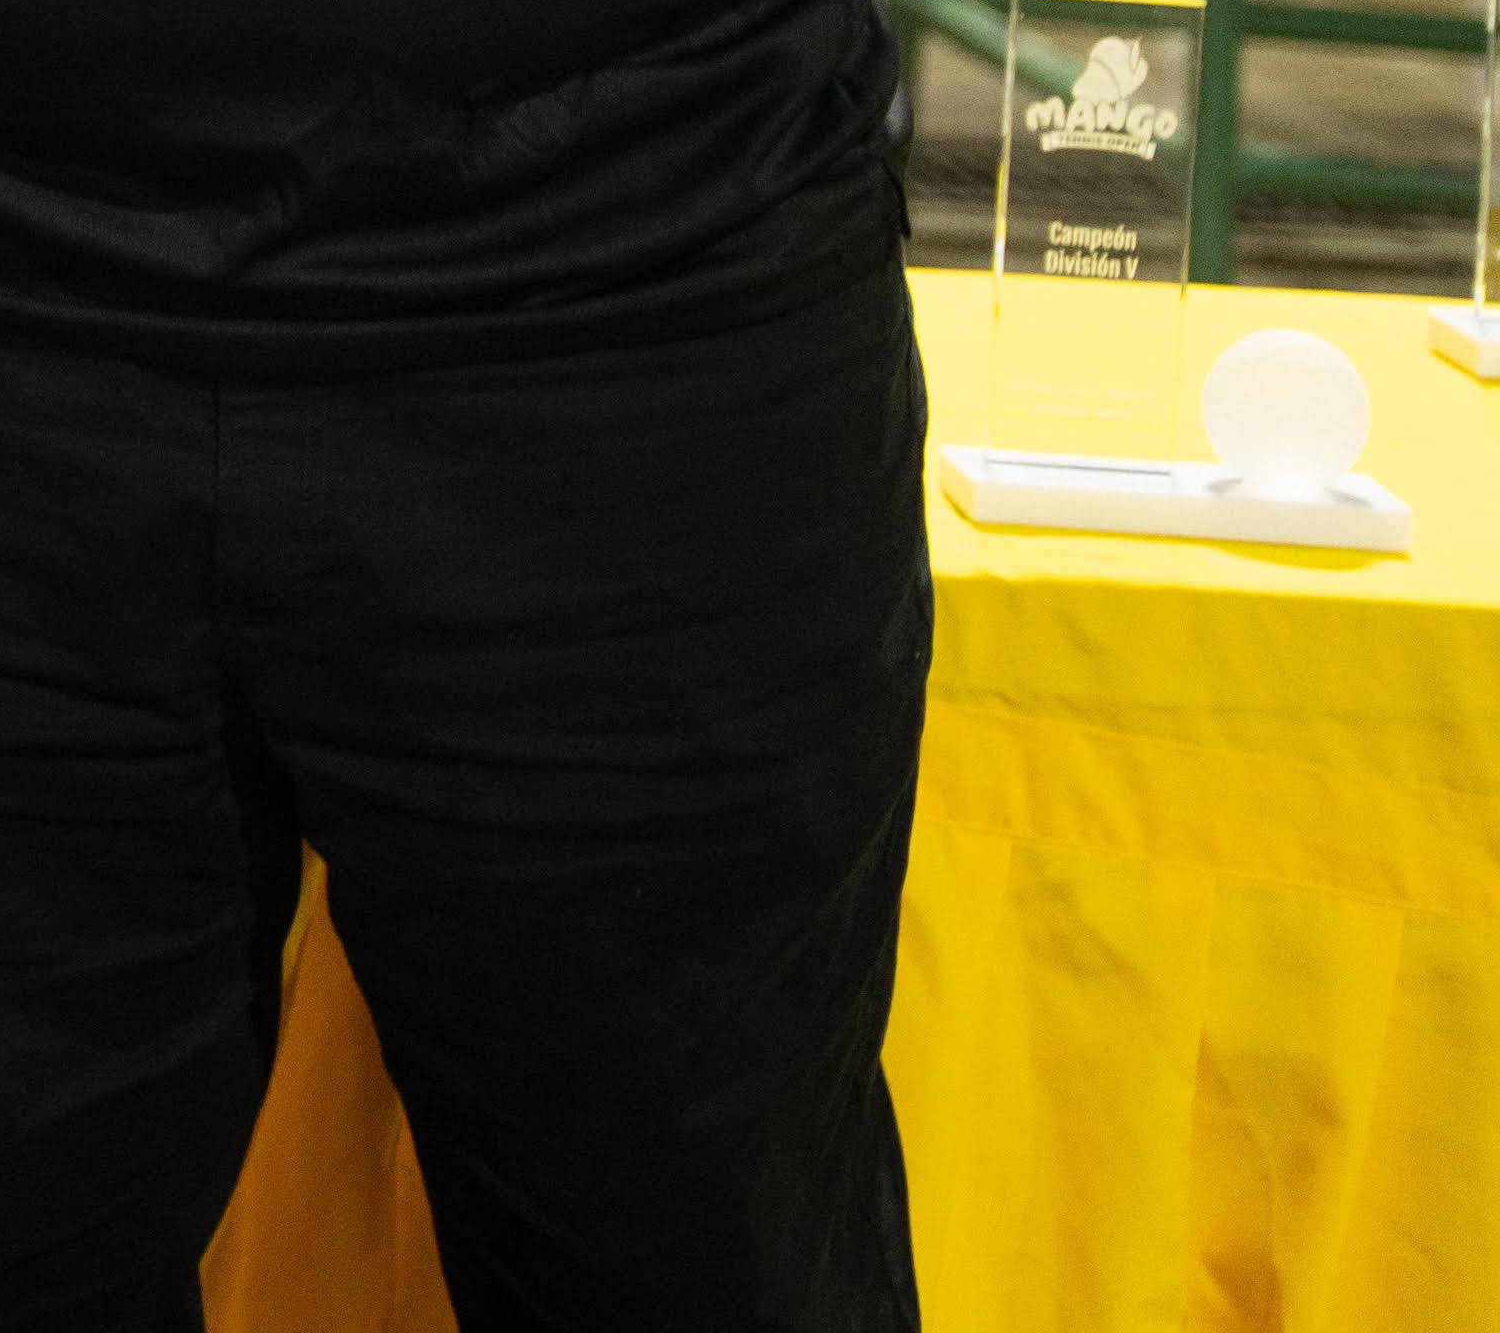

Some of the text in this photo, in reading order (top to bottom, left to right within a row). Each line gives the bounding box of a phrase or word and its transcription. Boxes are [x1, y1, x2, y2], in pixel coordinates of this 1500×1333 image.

[1025, 96, 1179, 141] MANGO
[1047, 220, 1138, 253] Campeón
[1043, 248, 1140, 280] División V
